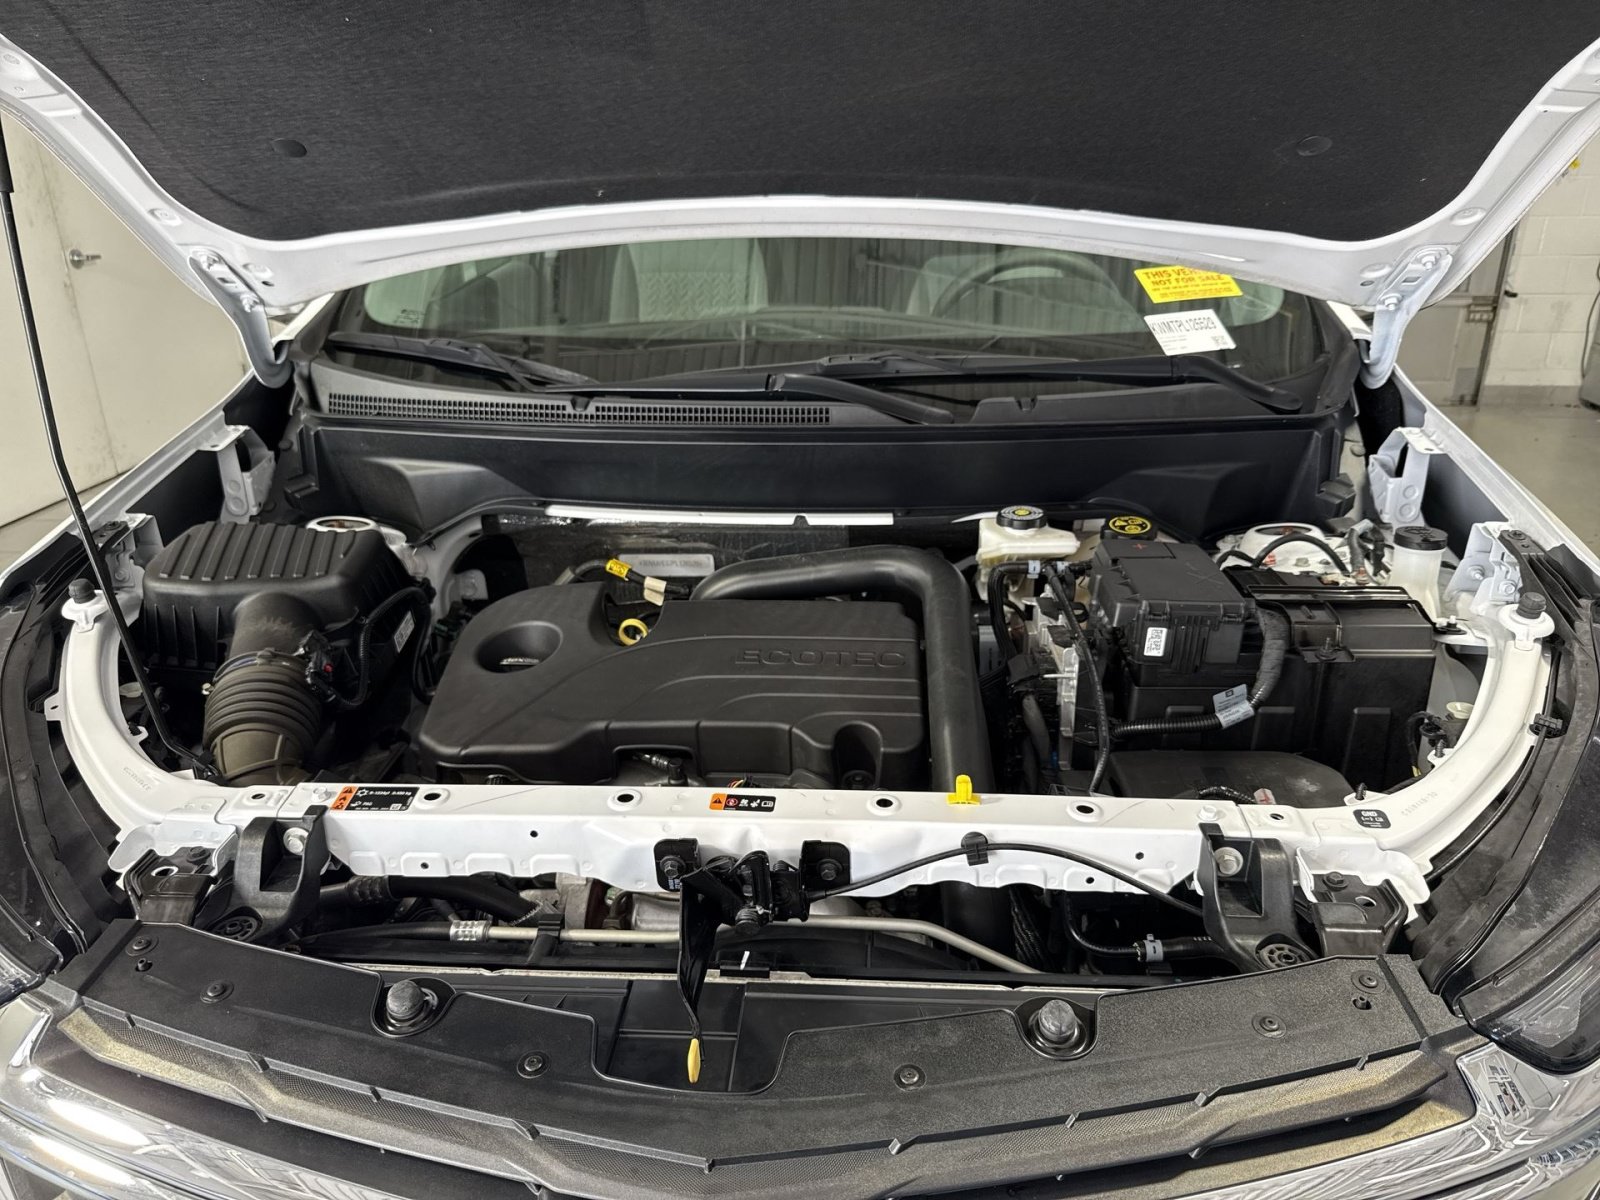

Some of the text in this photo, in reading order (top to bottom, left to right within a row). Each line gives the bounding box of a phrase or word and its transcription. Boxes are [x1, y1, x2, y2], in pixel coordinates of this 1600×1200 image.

[1143, 270, 1172, 280] THIS
[1151, 278, 1173, 286] NOT
[1174, 277, 1195, 285] FOR
[1200, 274, 1224, 283] SALE
[735, 650, 906, 668] ECOTEC
